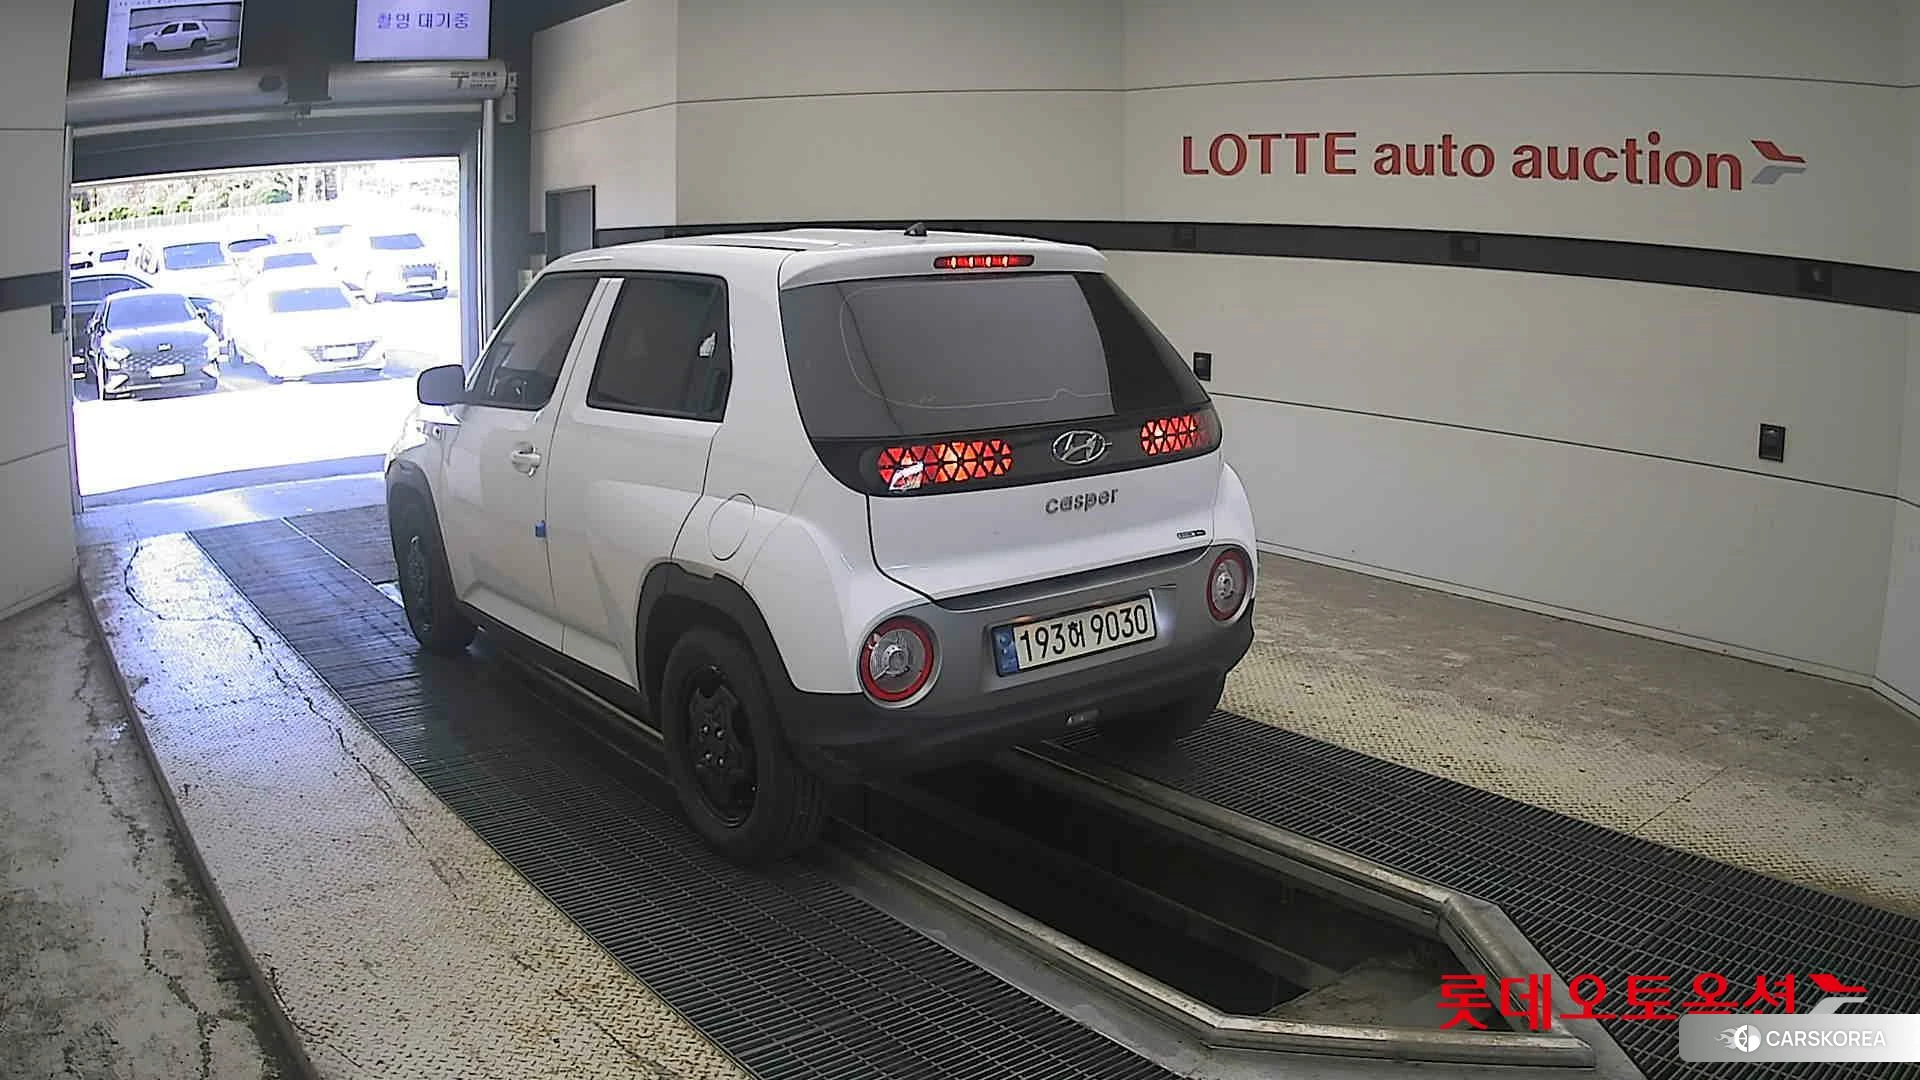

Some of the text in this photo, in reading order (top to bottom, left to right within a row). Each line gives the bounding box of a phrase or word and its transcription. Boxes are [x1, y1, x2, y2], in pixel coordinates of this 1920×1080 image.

[418, 12, 469, 30] 대기중
[1182, 131, 1742, 191] LOTTE auto auction
[1045, 488, 1119, 514] casper
[1020, 604, 1148, 662] 193허 9030
